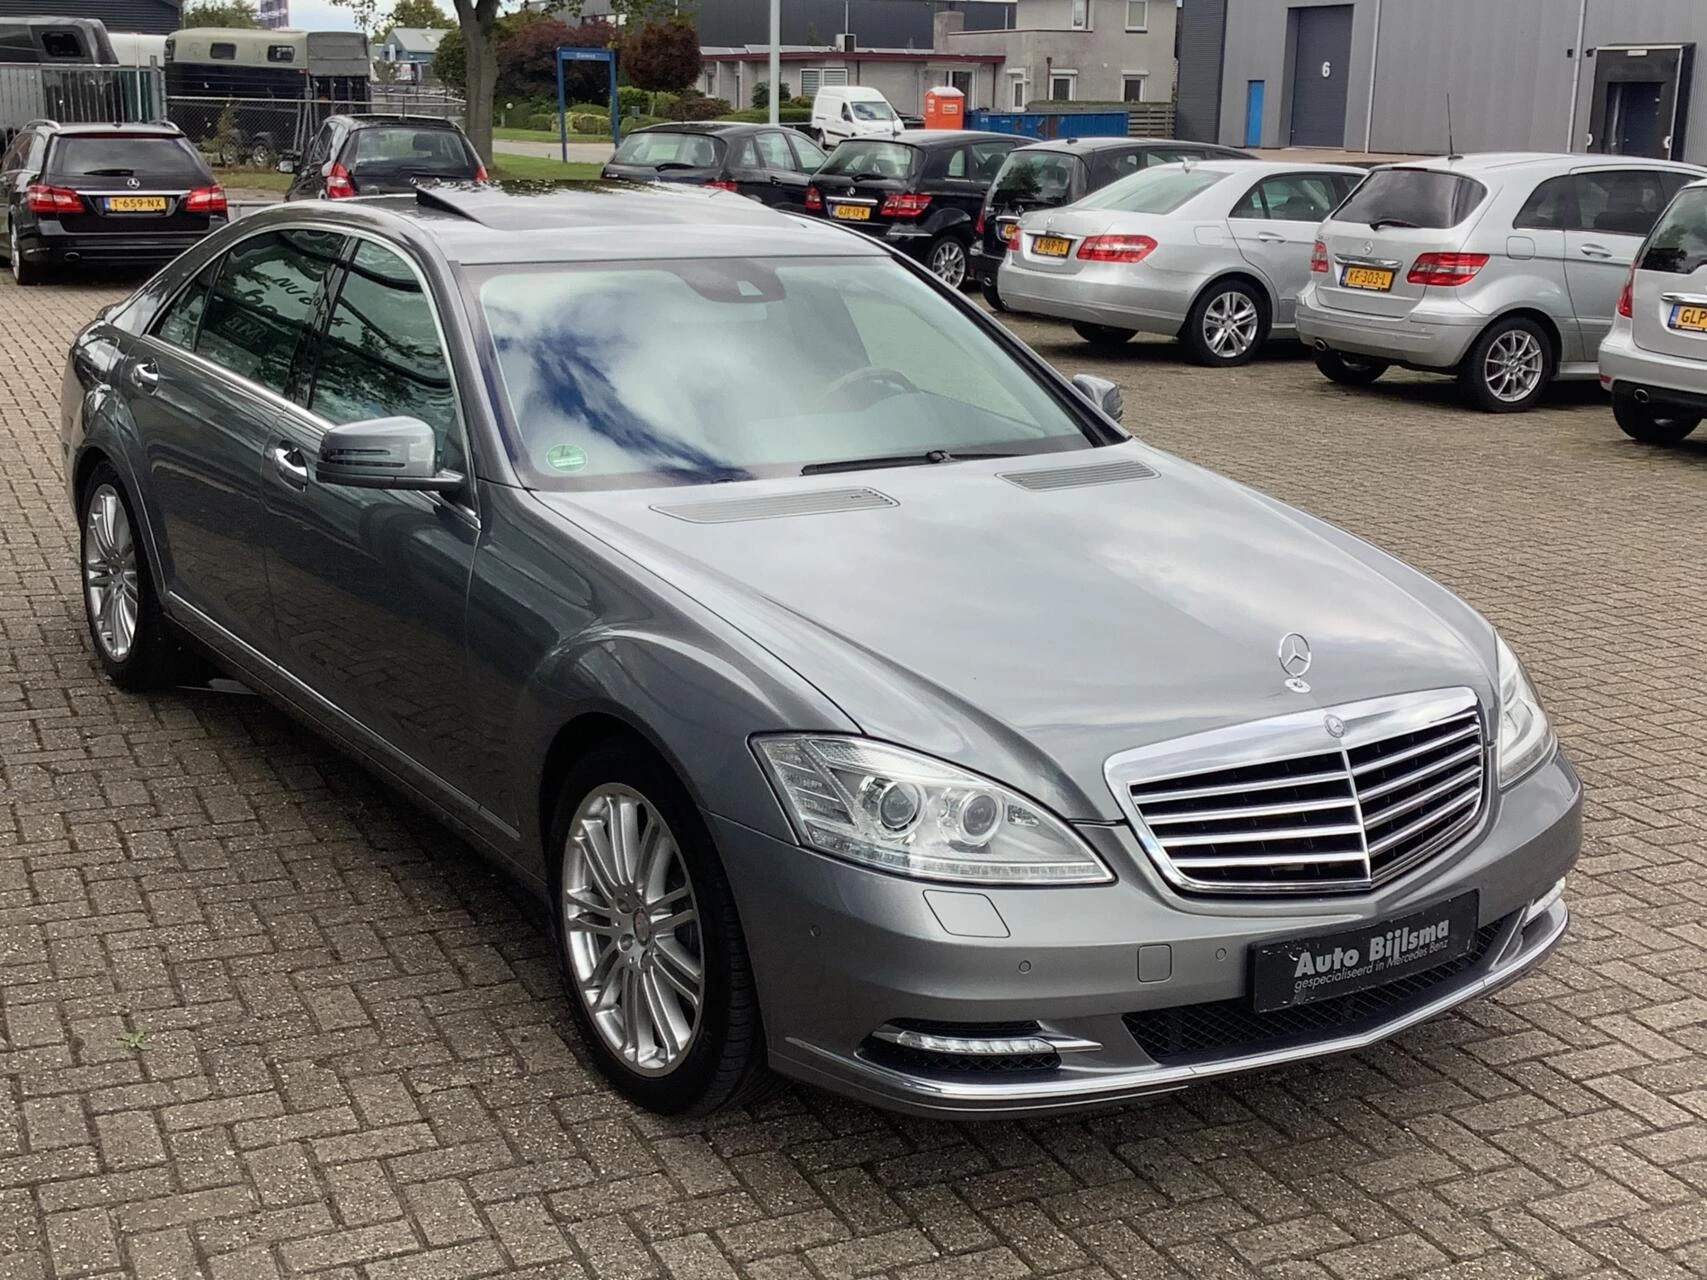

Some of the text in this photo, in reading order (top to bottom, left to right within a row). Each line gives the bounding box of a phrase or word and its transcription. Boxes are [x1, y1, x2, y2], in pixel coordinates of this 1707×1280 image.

[1322, 61, 1331, 78] 6
[111, 198, 162, 209] T-659-NX
[1348, 269, 1387, 286] KF-303-L
[1294, 919, 1450, 978] Auto Bijlsma
[1294, 962, 1373, 993] gespecialiseerd
[1375, 960, 1384, 972] in
[1429, 939, 1448, 954] Benz
